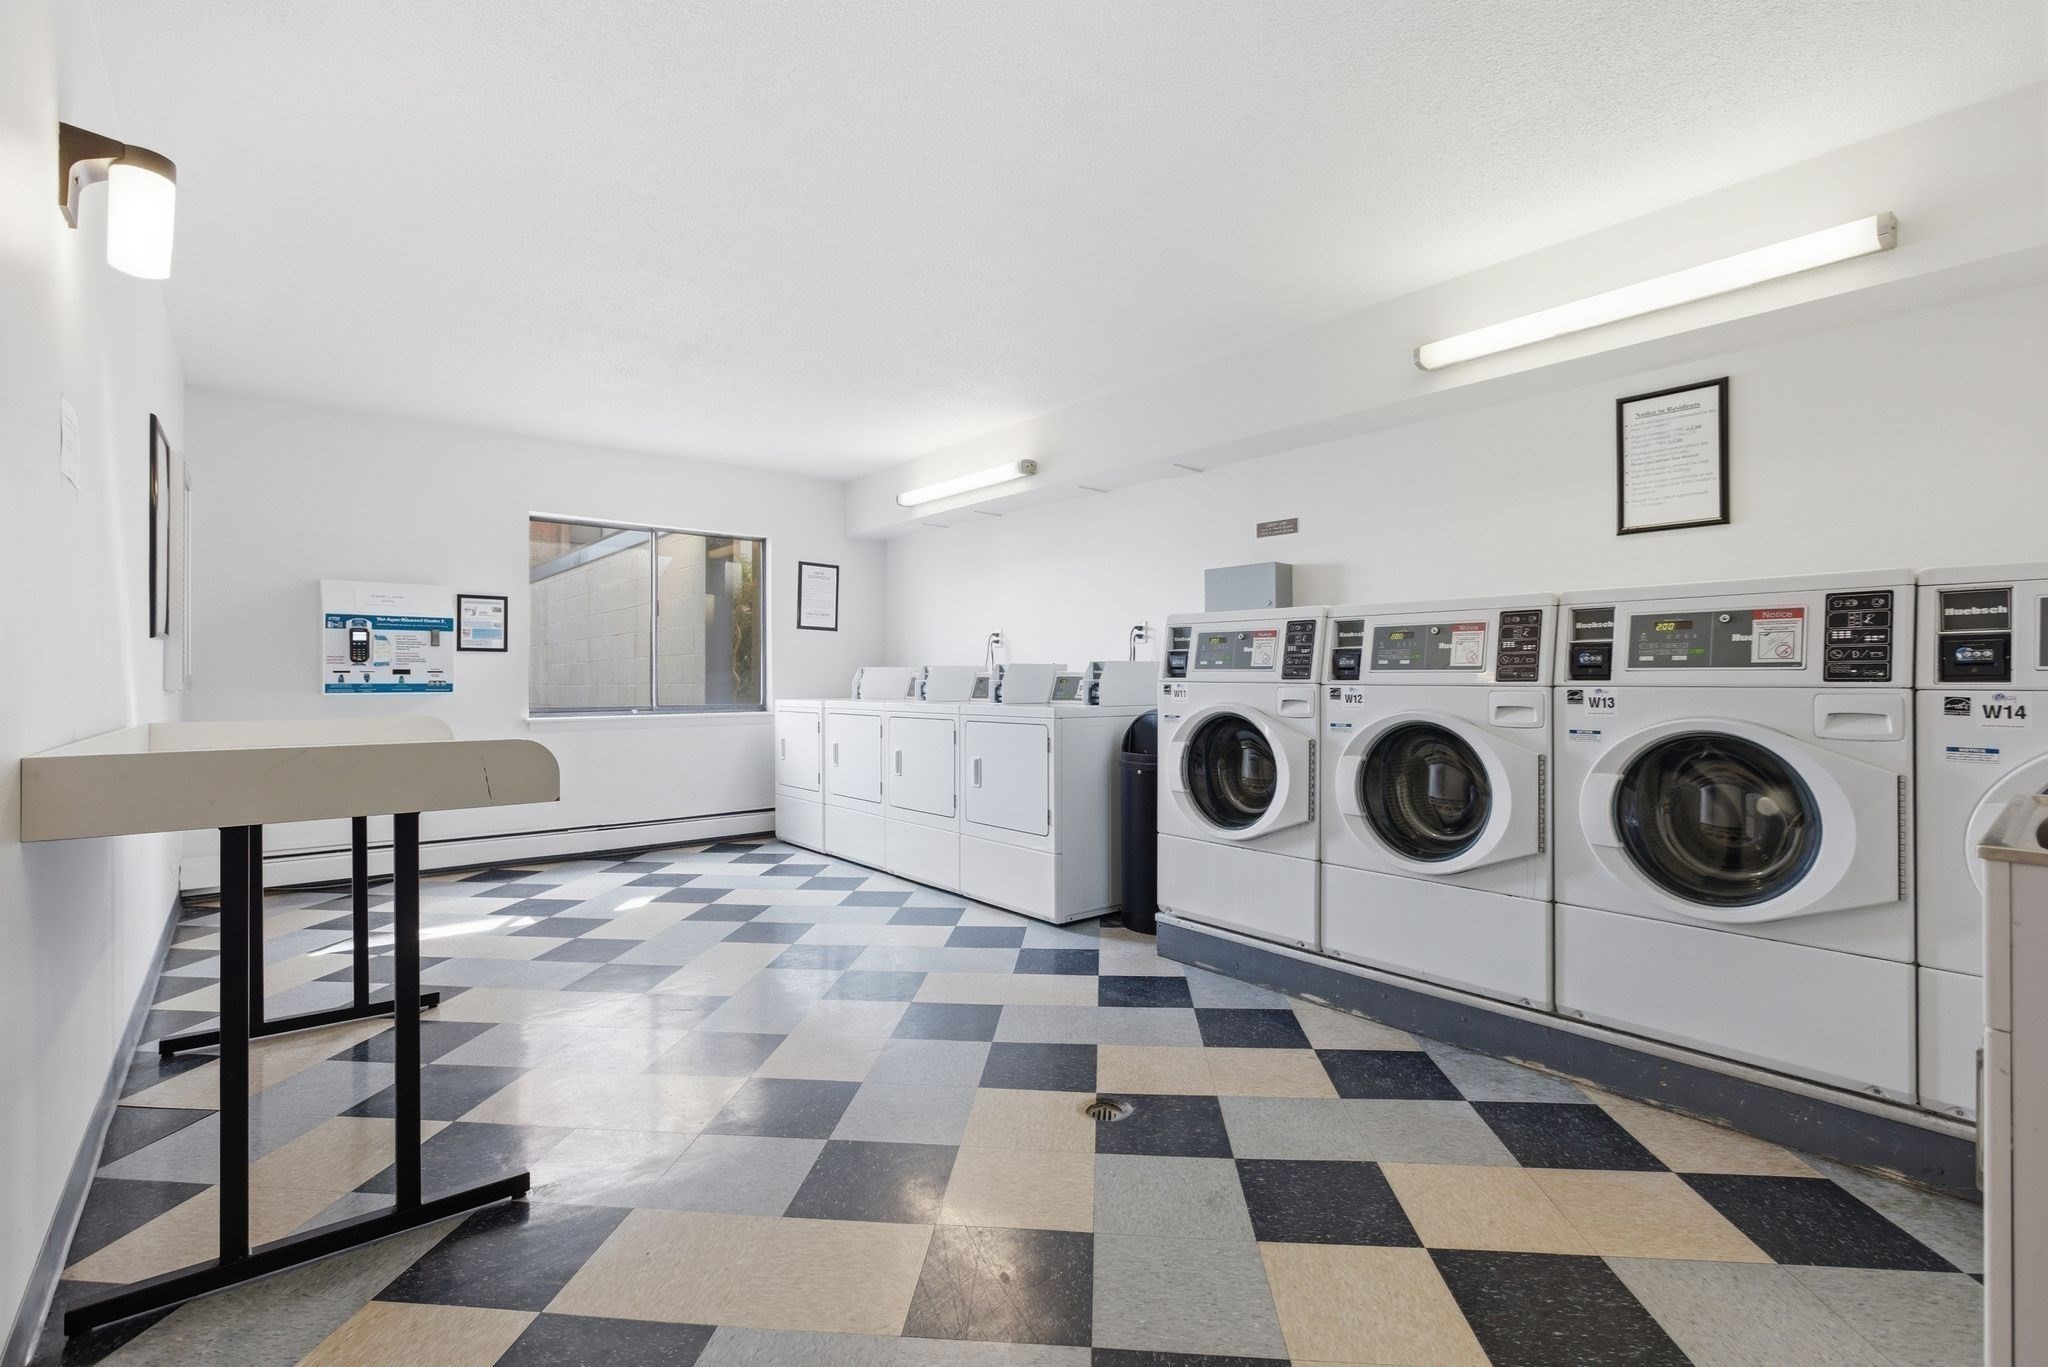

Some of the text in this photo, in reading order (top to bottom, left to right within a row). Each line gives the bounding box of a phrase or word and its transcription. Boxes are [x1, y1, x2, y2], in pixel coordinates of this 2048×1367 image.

[1944, 605, 2008, 616] Huebsch
[1173, 689, 1187, 698] W11
[1344, 694, 1363, 704] W12
[1588, 697, 1615, 709] W13
[1982, 704, 2027, 720] W14
